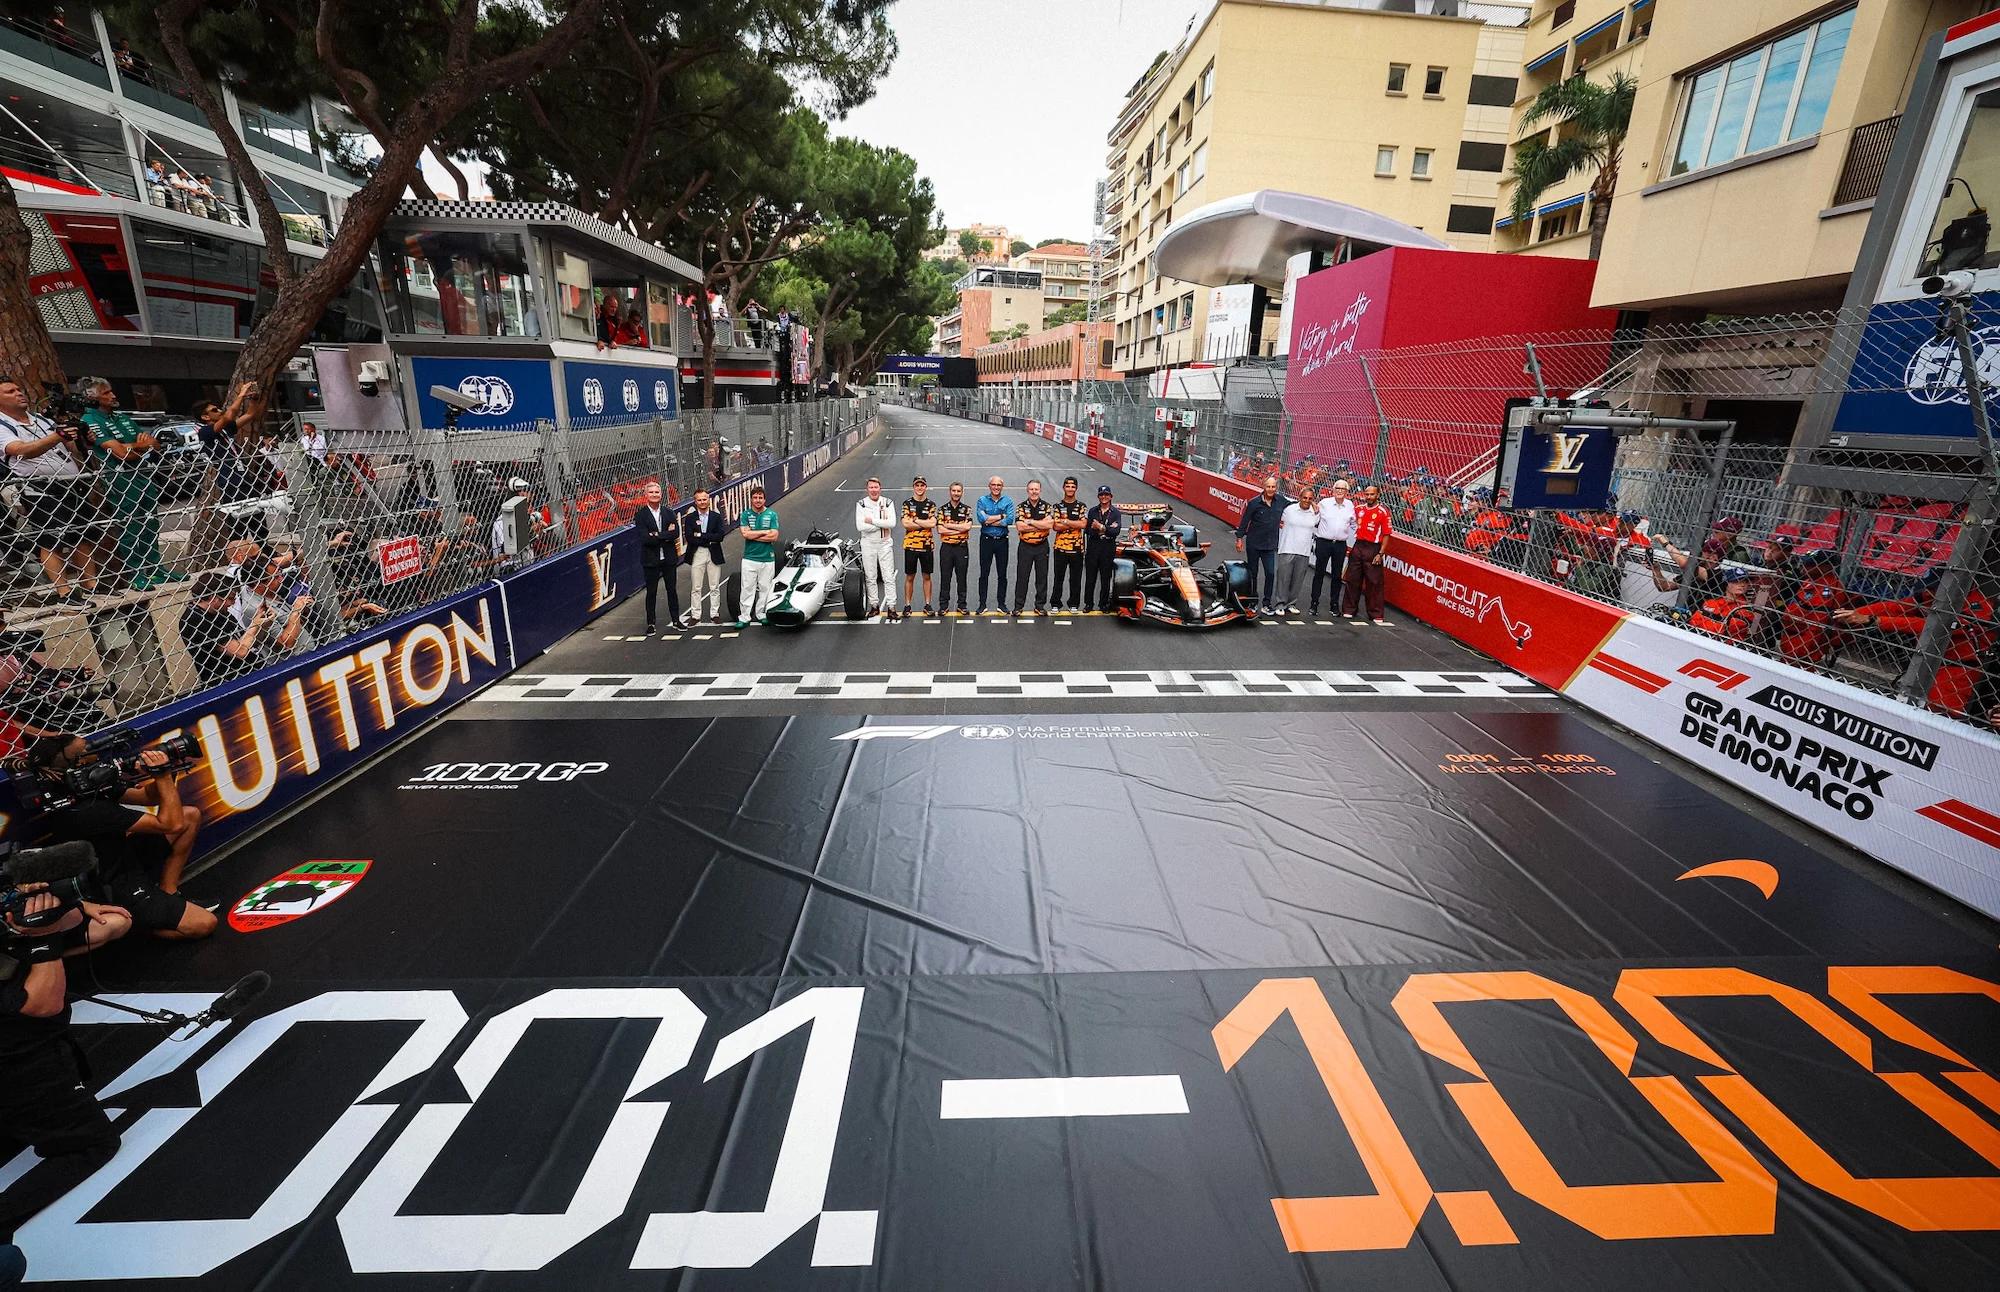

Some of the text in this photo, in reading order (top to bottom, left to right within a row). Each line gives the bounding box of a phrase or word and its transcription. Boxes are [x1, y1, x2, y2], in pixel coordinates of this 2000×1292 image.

[1341, 292, 1371, 331] better
[1323, 322, 1359, 367] shared
[1436, 595, 1476, 618] SINCE 1929
[125, 598, 497, 812] UITTON
[1018, 731, 1071, 739] World
[1685, 692, 1893, 798] GRAND PRIX
[1770, 690, 1931, 765] LOUIS VUITTON
[536, 762, 610, 782] GP
[1438, 764, 1617, 776] McLaren Racing
[1445, 754, 1500, 763] 0001
[1541, 754, 1596, 763] 1000
[1680, 714, 1874, 820] DE MONACO
